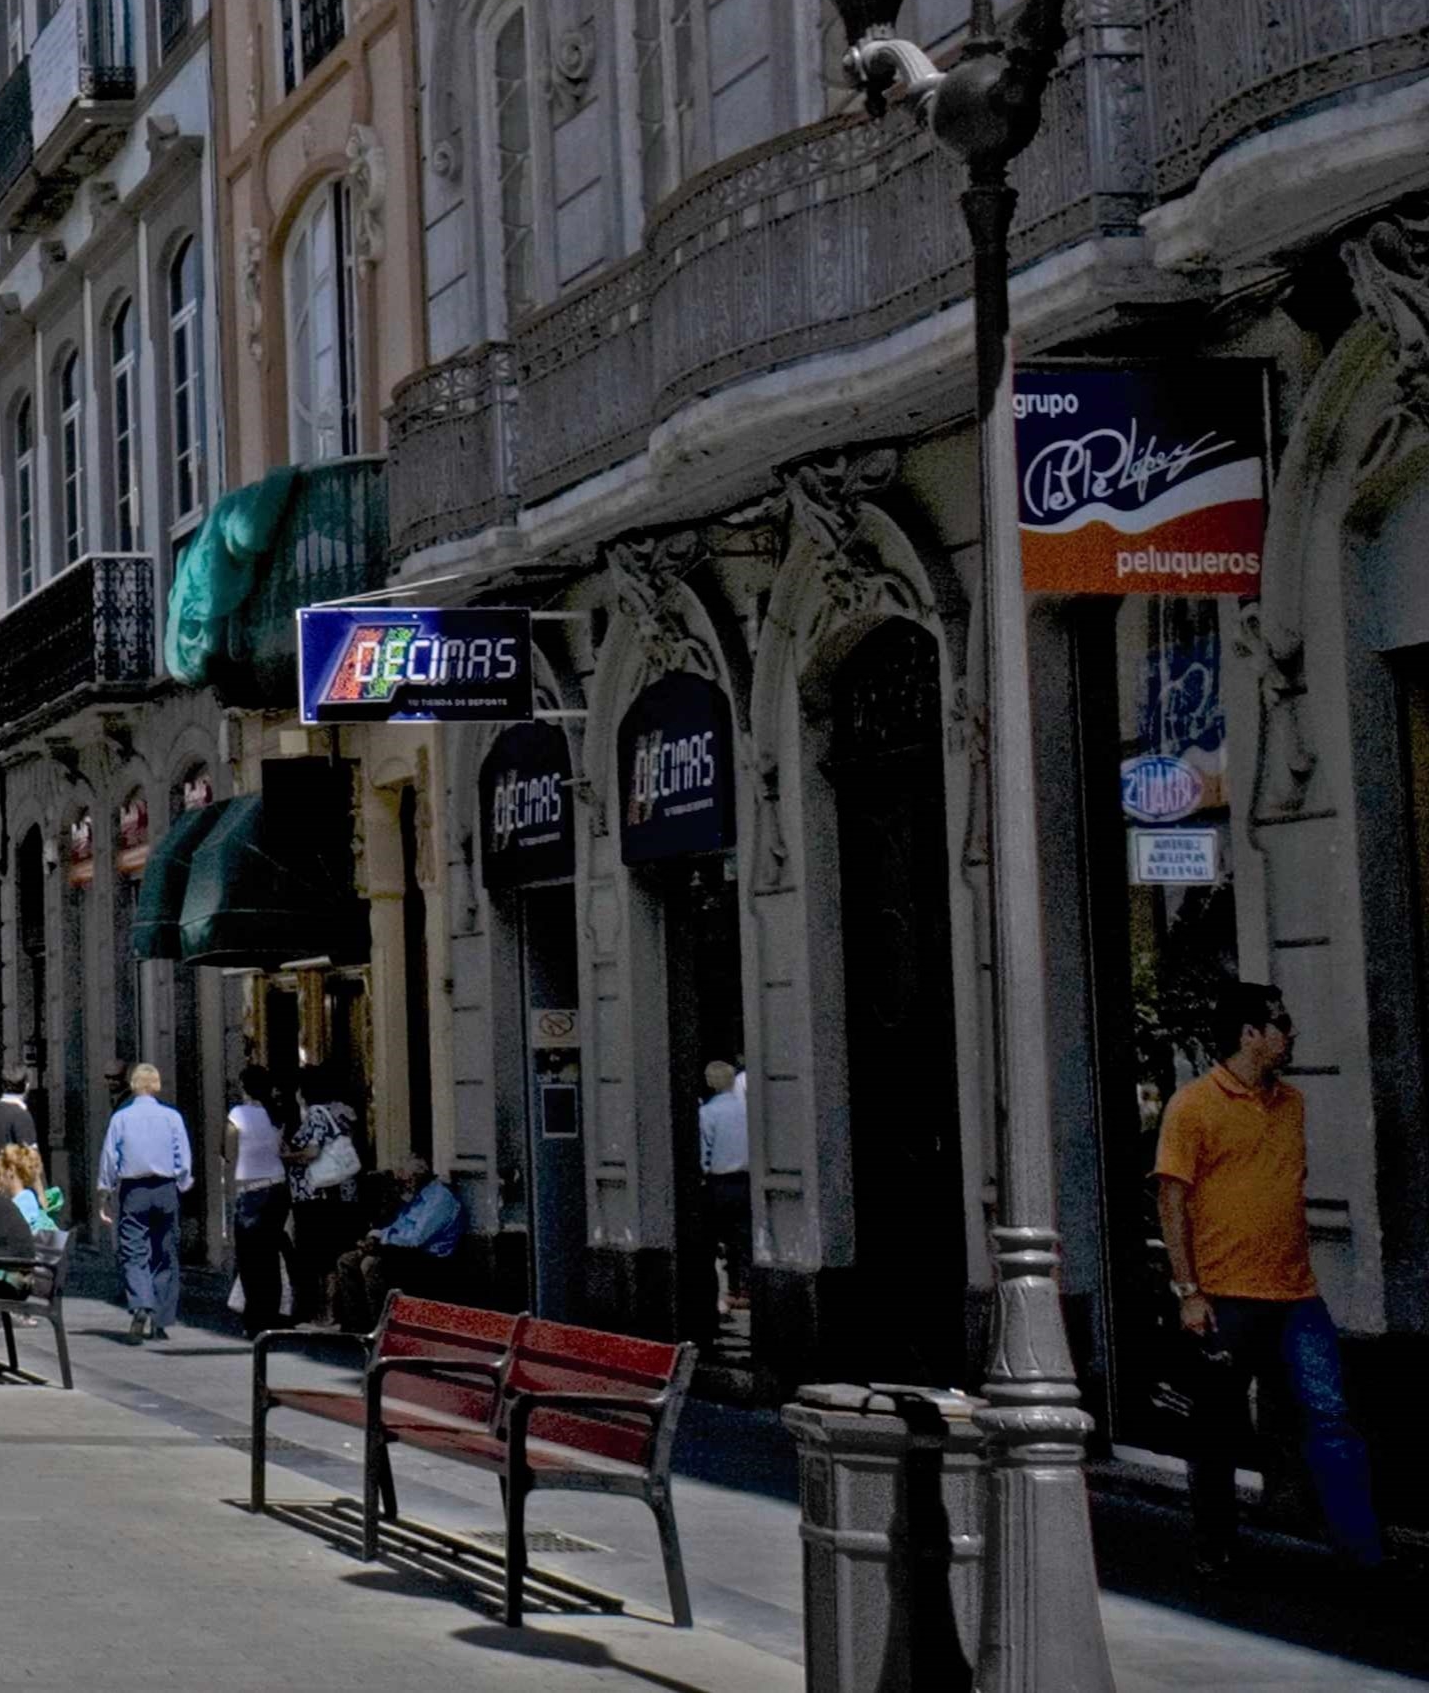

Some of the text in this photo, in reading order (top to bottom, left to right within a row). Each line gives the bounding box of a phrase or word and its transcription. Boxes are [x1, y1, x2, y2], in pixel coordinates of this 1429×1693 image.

[1013, 392, 1079, 419] grupo
[1116, 545, 1261, 579] peluqueros
[354, 637, 517, 683] DECIMAS
[634, 730, 715, 802] DECIMAS
